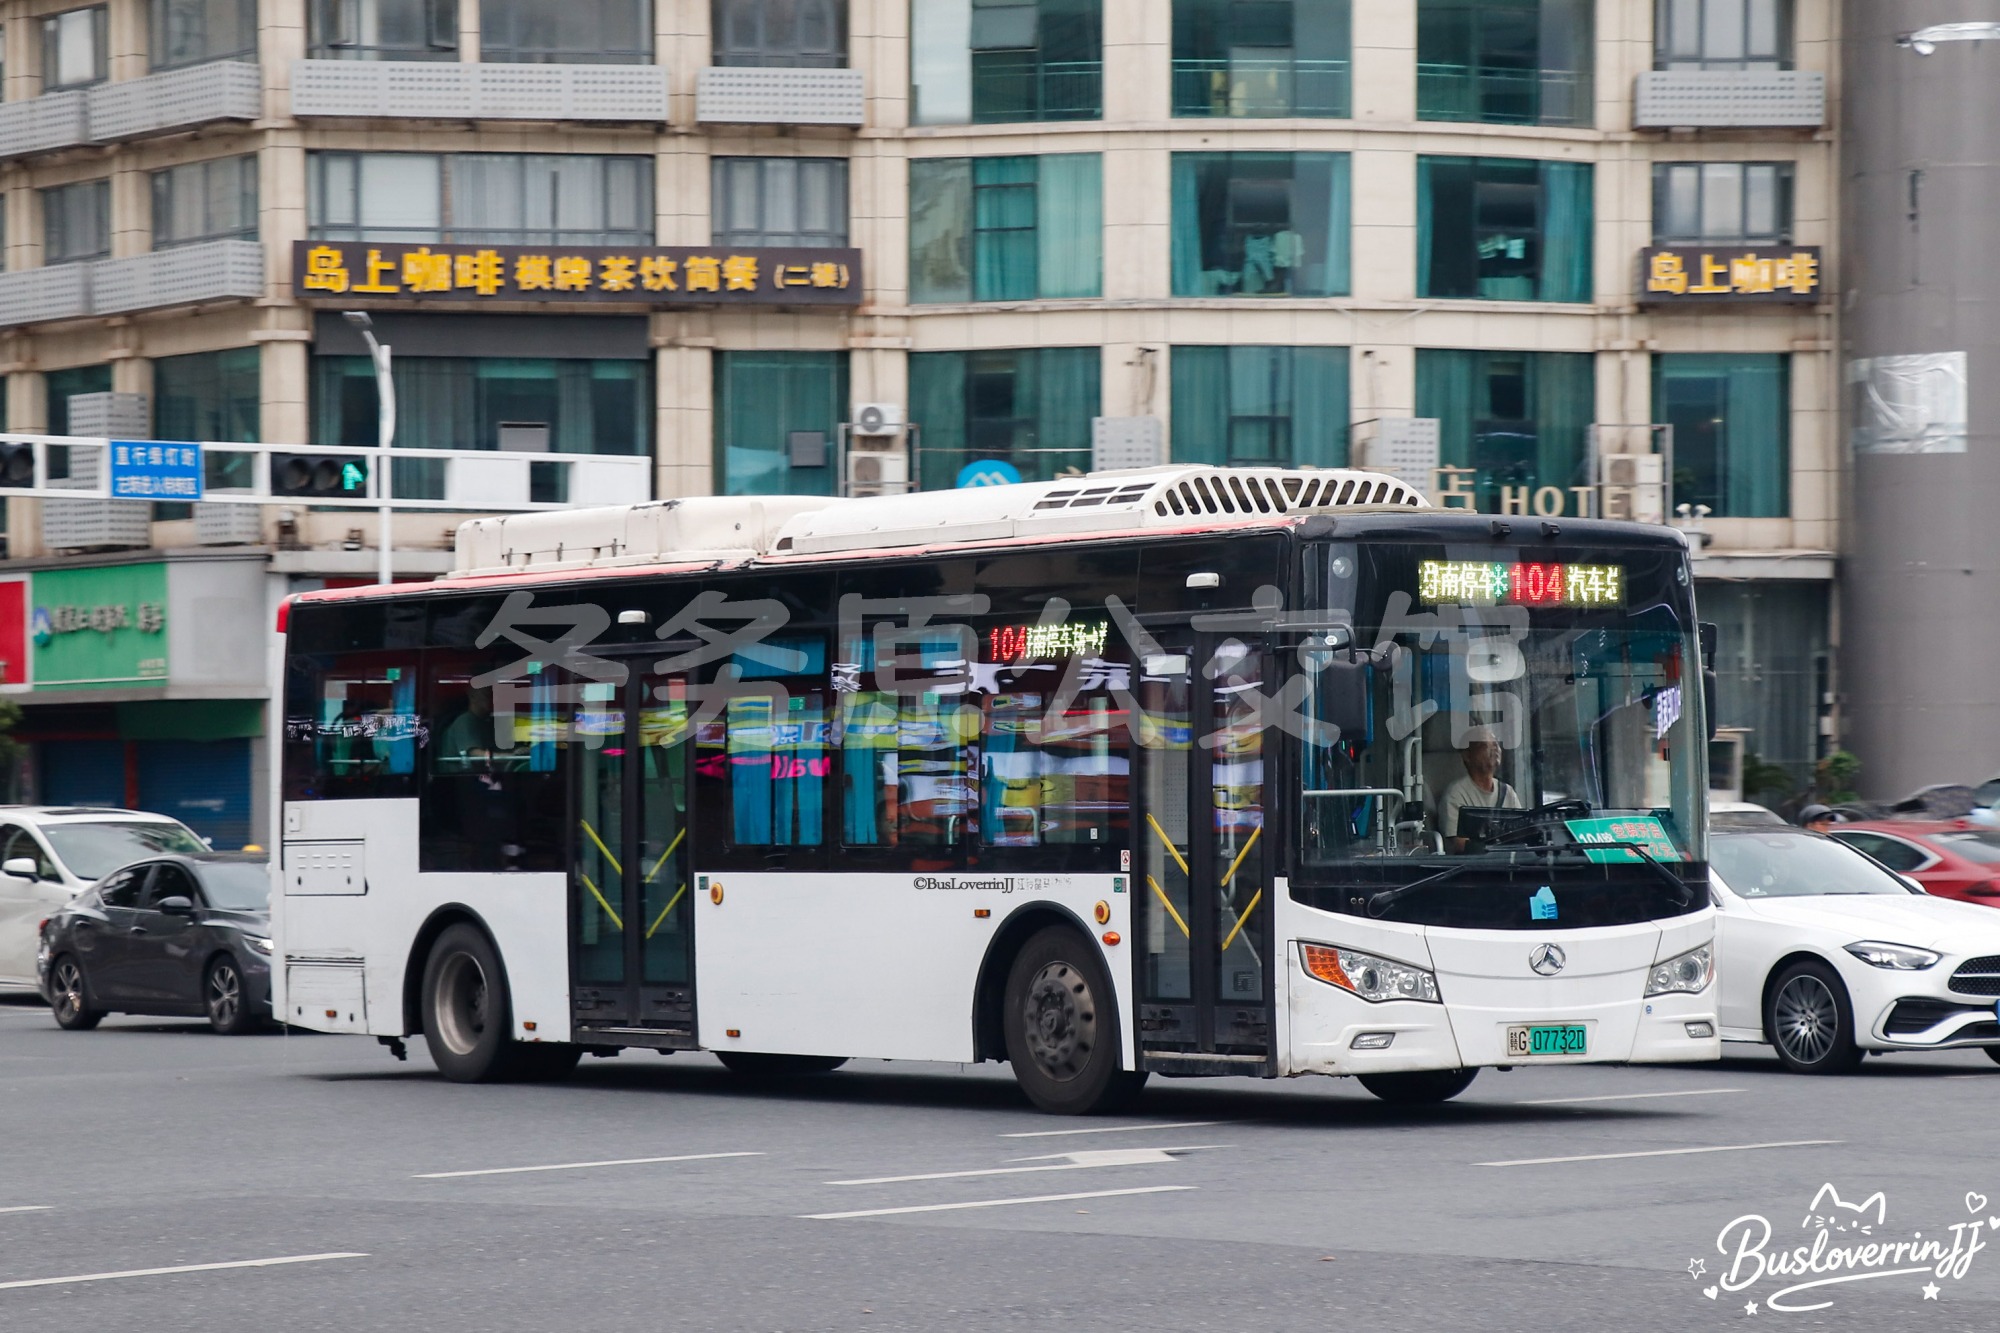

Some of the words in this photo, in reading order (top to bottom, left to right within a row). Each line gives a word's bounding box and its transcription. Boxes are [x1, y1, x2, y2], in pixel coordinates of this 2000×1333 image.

[303, 246, 505, 295] 岛上咖啡
[515, 254, 760, 292] 棋牌茶饮简餐
[1648, 252, 1819, 294] 岛上咖啡
[1511, 563, 1562, 600] 104
[990, 627, 1025, 660] 104
